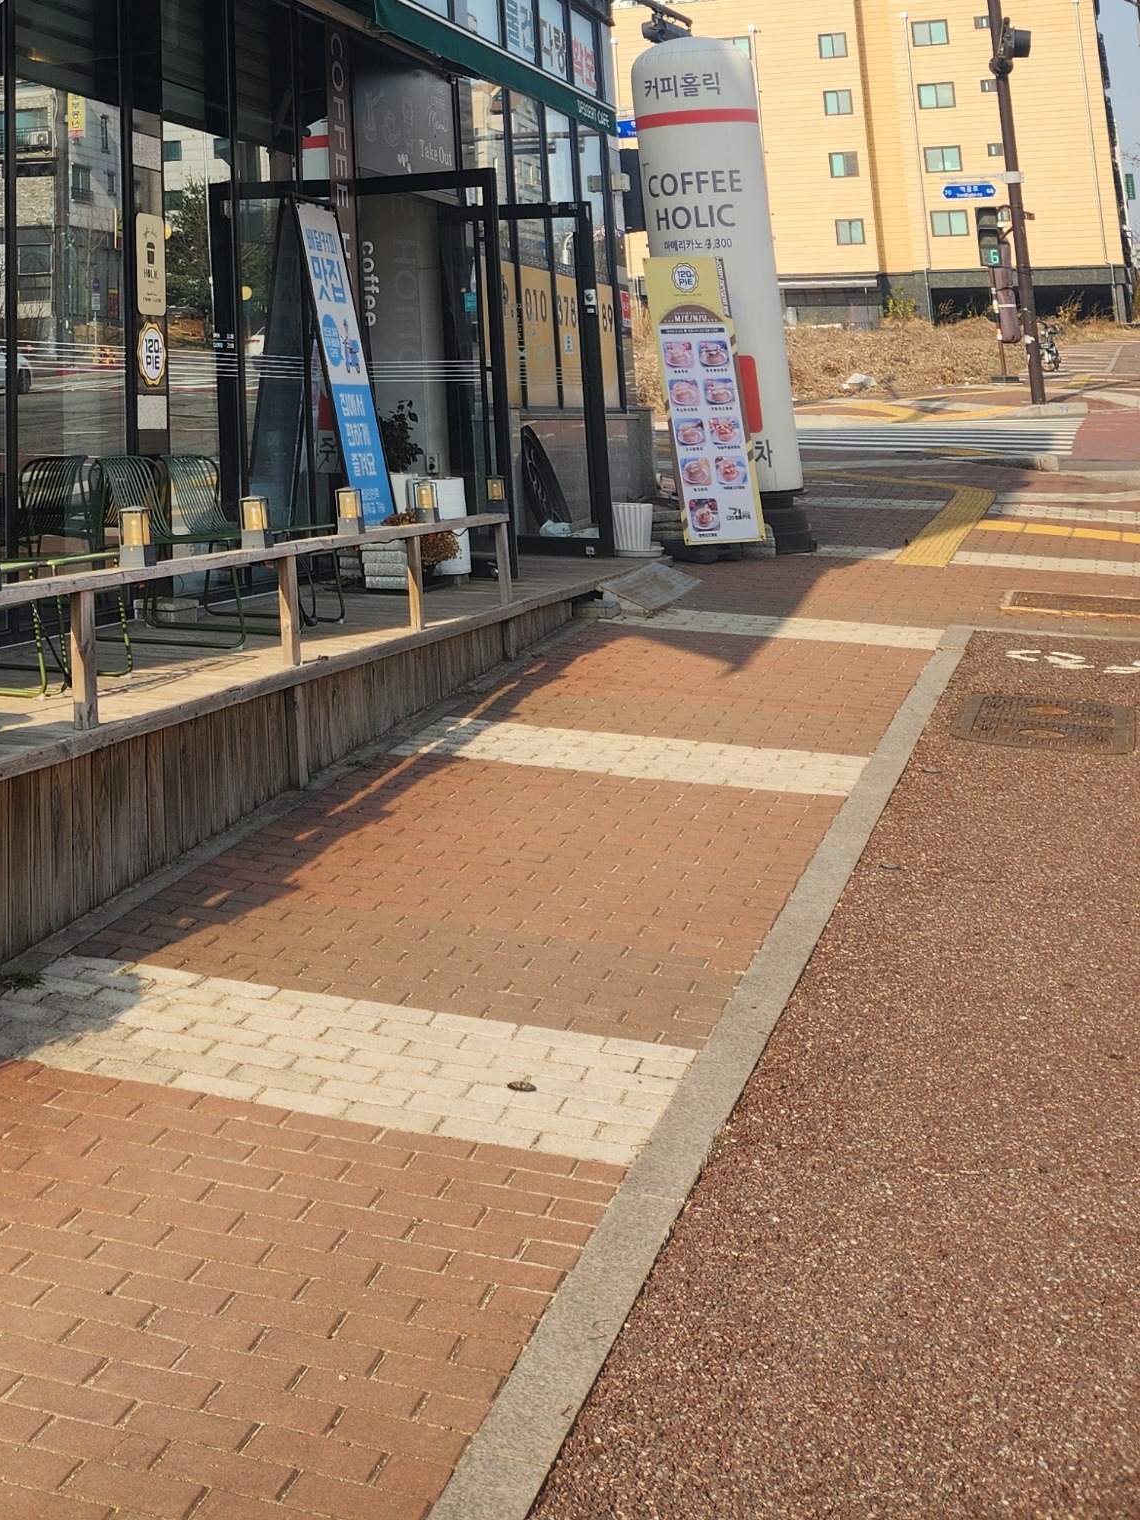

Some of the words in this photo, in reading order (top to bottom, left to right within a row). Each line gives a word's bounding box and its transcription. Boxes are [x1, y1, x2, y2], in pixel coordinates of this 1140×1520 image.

[644, 72, 721, 100] 커피홀릭
[330, 32, 349, 209] COFFEE
[420, 139, 438, 162] Take
[439, 146, 452, 167] Out
[648, 170, 742, 199] COFFEE
[656, 204, 735, 231] HOLIC
[663, 239, 703, 251] 아메리카노
[990, 249, 1000, 263] 6
[311, 256, 347, 304] 맛집
[361, 241, 379, 327] coffee
[146, 355, 160, 370] PIE
[339, 393, 365, 417] 집에서
[345, 423, 372, 446] 편하게
[351, 453, 377, 477] 즐겨요
[755, 440, 773, 468] 차
